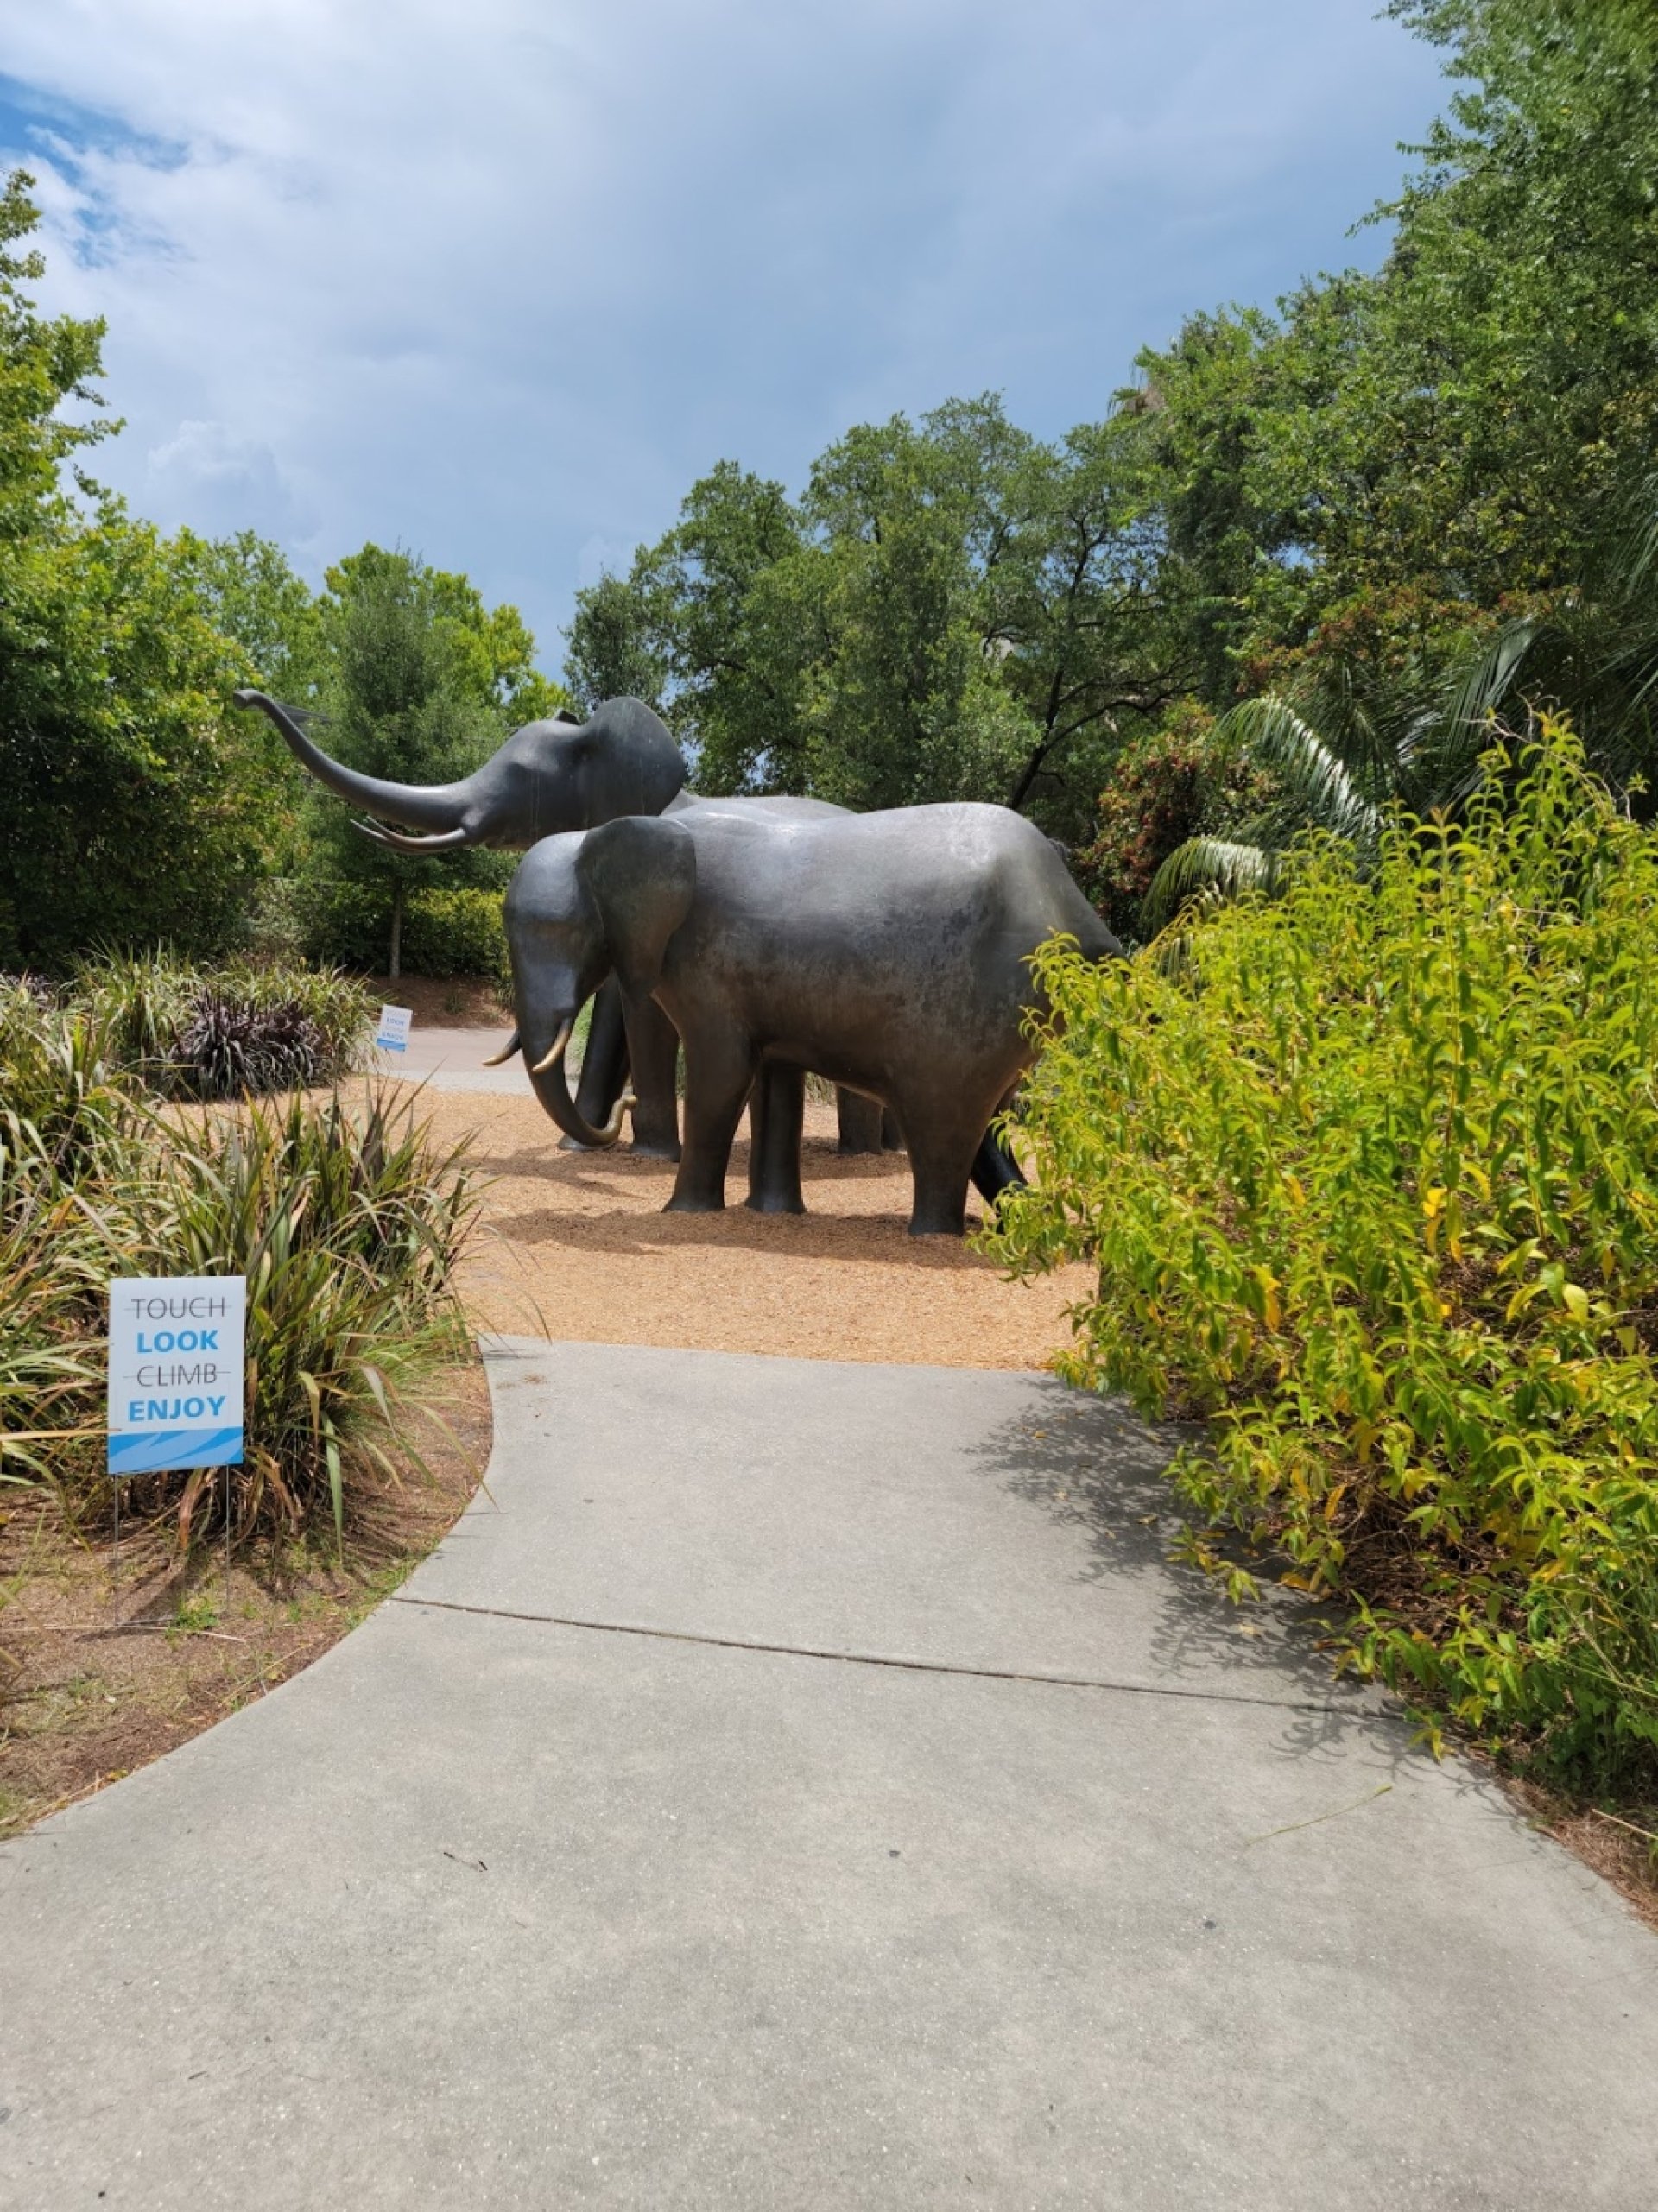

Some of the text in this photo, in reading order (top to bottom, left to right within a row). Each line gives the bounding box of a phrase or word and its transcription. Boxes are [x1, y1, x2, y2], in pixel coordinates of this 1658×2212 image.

[130, 1296, 225, 1319] TOUCH
[136, 1330, 219, 1353] LOOK
[136, 1363, 218, 1387] CLIMB
[128, 1395, 226, 1422] ENJOY
